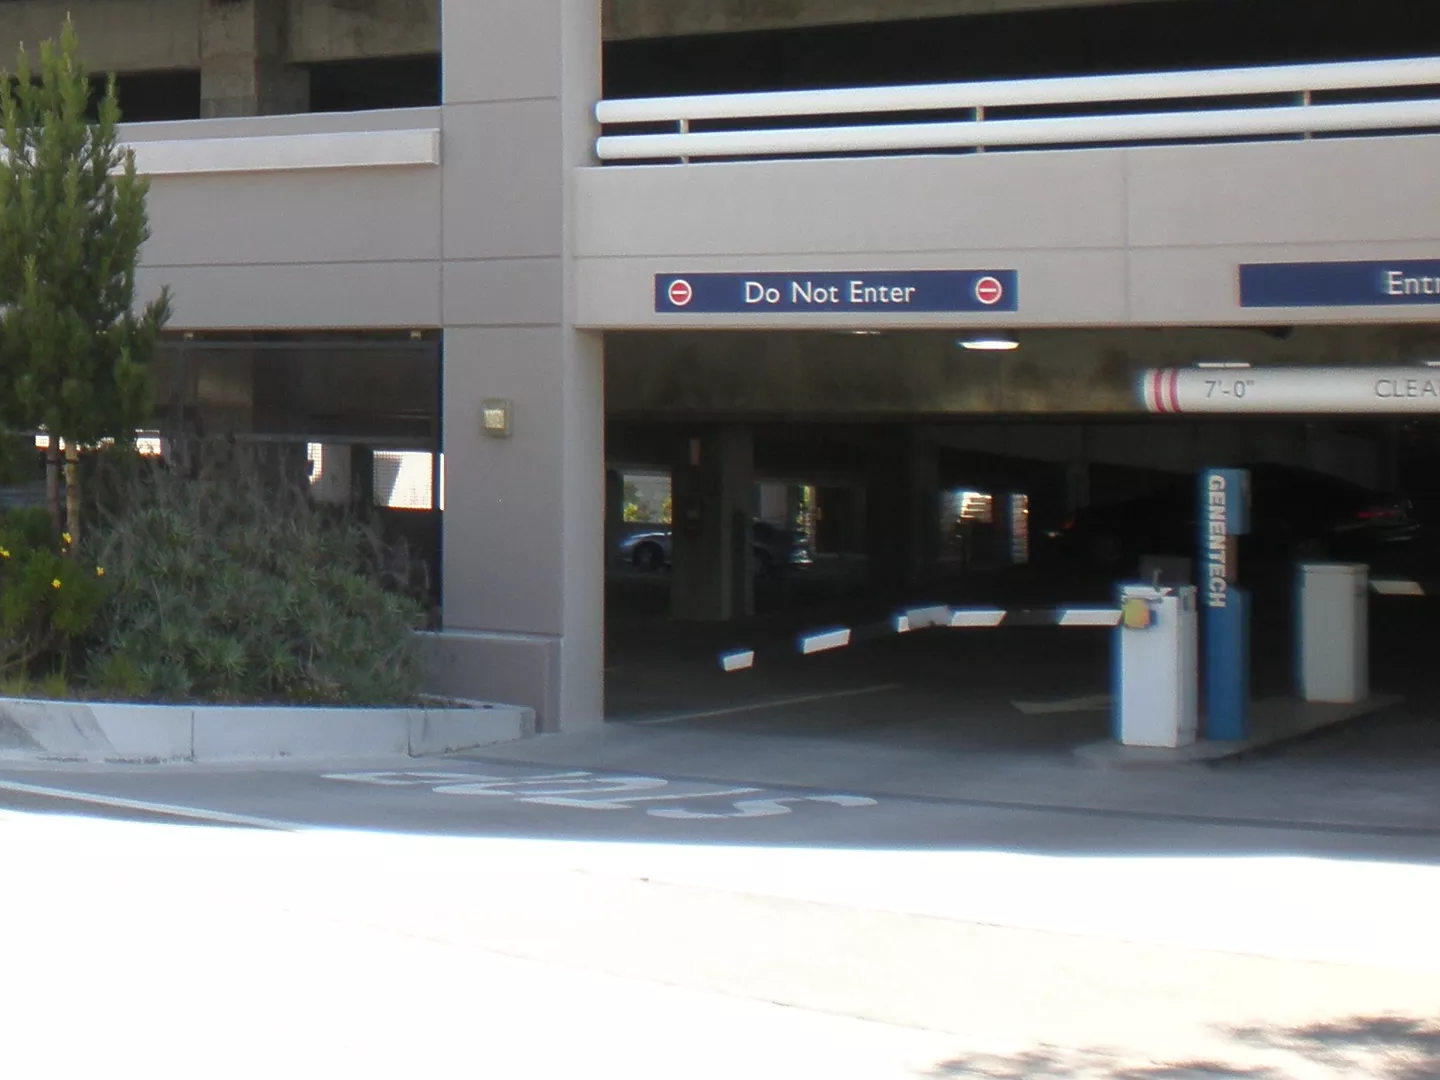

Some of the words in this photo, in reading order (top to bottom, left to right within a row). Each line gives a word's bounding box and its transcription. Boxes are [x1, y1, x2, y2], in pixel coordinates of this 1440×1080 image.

[744, 281, 780, 304] Do
[791, 281, 839, 303] Not
[850, 281, 916, 303] Enter
[1208, 474, 1227, 608] GENENTECH
[319, 770, 878, 819] STOP
